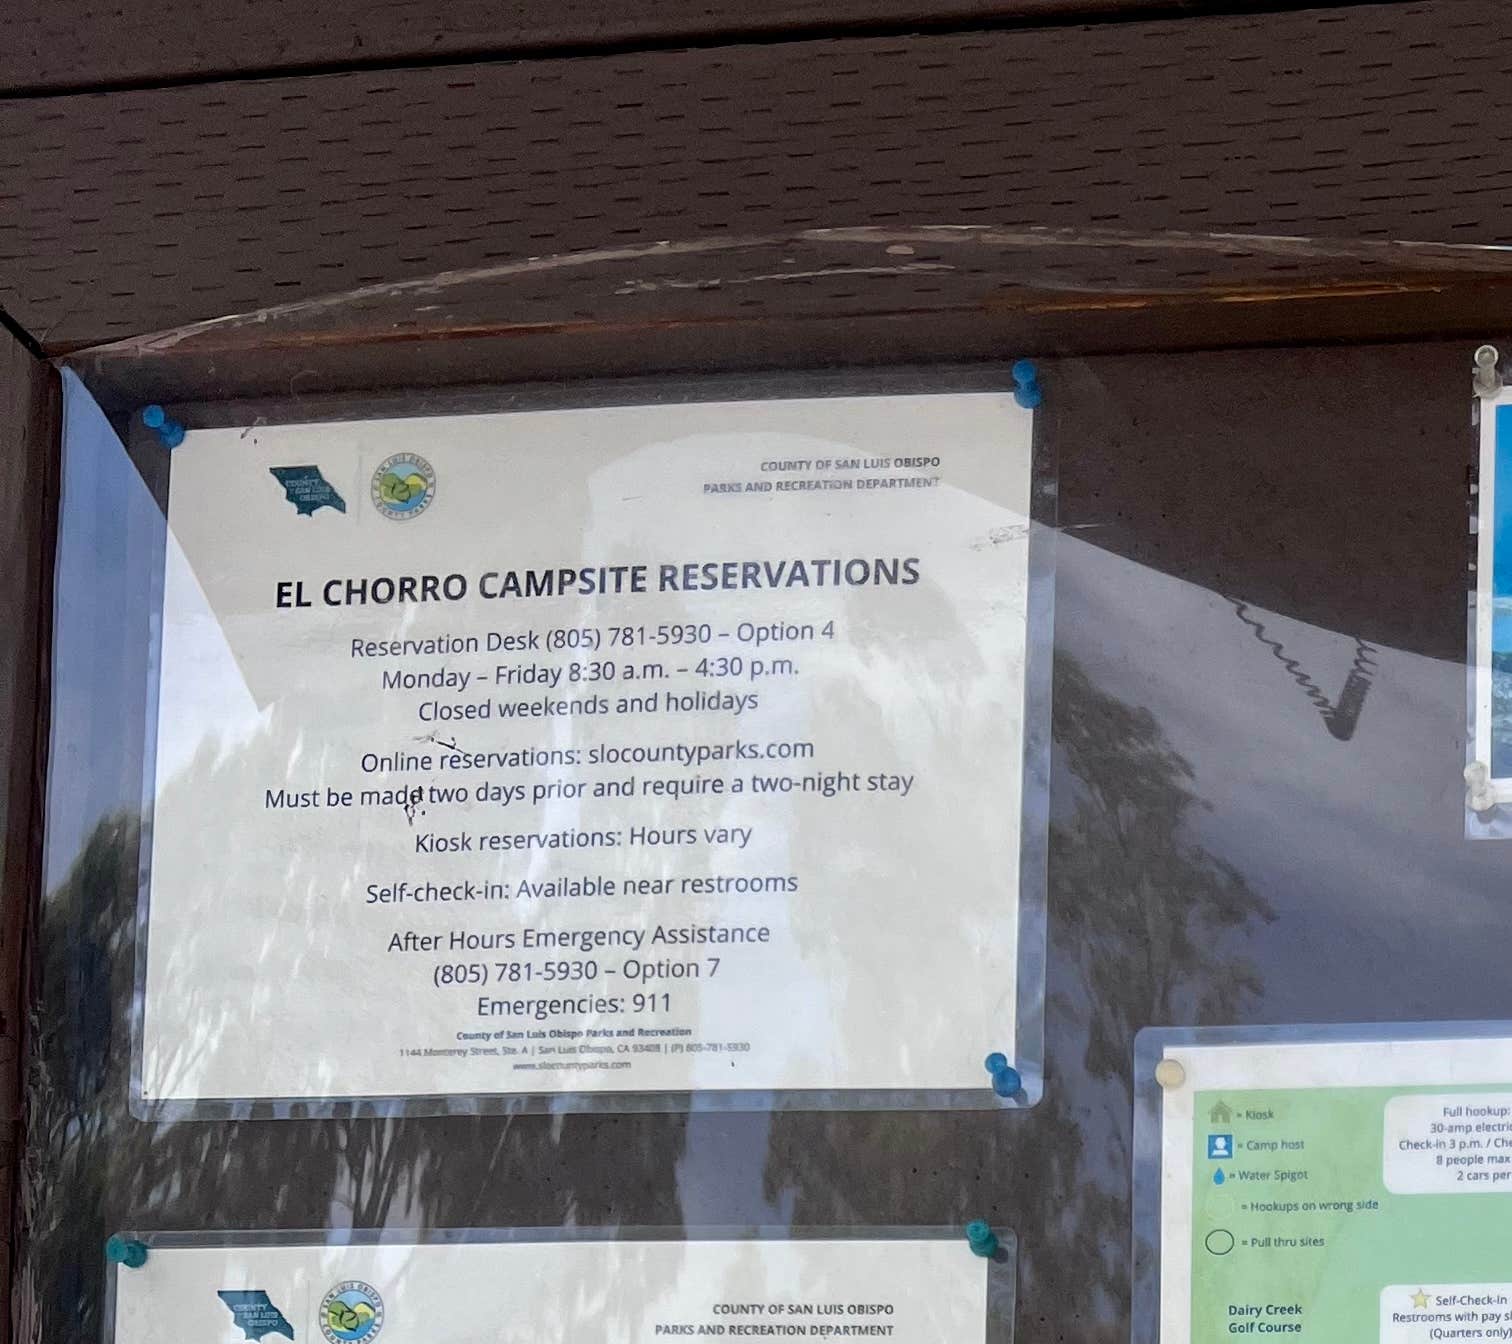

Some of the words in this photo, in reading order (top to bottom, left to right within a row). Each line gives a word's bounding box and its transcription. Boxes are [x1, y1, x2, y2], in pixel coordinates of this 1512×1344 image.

[276, 581, 312, 608] EL
[323, 573, 467, 607] CHORRO
[479, 565, 647, 599] CAMPSITE
[659, 558, 920, 592] RESERVATIONS
[418, 698, 491, 722] Closed
[498, 694, 609, 718] weekends
[615, 692, 658, 714] and
[666, 690, 759, 716] holidays
[361, 751, 433, 773] Online
[438, 745, 581, 770] reservations:
[588, 739, 814, 767] slocountyparks.com
[415, 831, 472, 853] Kiosk
[479, 828, 622, 851] reservations:
[630, 826, 697, 846] Hours
[703, 828, 752, 849] vary
[366, 880, 510, 904] Self-check-in:
[516, 875, 616, 898] Available
[623, 879, 675, 896] near
[681, 876, 798, 894] restrooms
[1456, 1170, 1464, 1181] 2
[1466, 1172, 1490, 1181] cars
[1492, 1171, 1512, 1183] per
[1228, 1304, 1263, 1319] Dairy
[1265, 1303, 1302, 1316] Creek
[655, 1324, 695, 1336] PARKS
[697, 1324, 726, 1336] AND
[728, 1324, 806, 1336] RECREATION
[809, 1325, 894, 1336] DEPARTMENT
[1228, 1321, 1256, 1334] Golf
[1257, 1322, 1302, 1333] Course
[1429, 1327, 1483, 1340] (Quarters
[1485, 1326, 1512, 1340] only)
